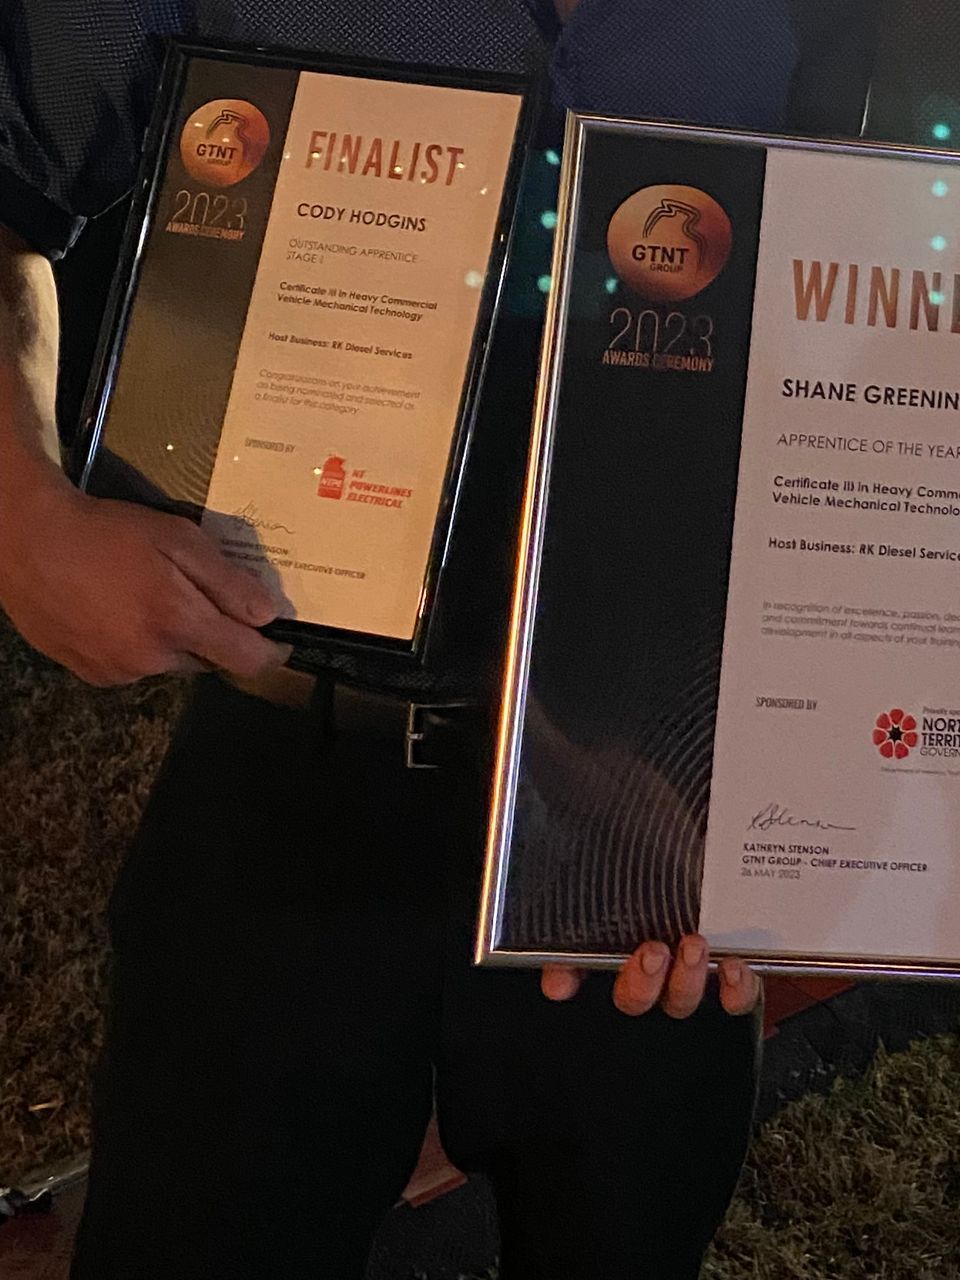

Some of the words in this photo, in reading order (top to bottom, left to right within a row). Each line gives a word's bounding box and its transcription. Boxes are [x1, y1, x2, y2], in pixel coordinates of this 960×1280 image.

[196, 143, 237, 160] GTNT
[305, 130, 465, 186] FINALIST
[172, 190, 248, 229] 2023
[297, 202, 346, 221] CODY
[349, 209, 426, 232] HODGINS
[286, 250, 317, 263] STAGE
[289, 238, 357, 256] OUTSTANDING
[360, 247, 419, 263] APPRENTICE
[632, 244, 690, 265] GTNT
[650, 263, 684, 273] GROUP
[279, 281, 327, 296] Certificate
[350, 291, 379, 304] Heavy
[381, 295, 438, 310] Commercial
[277, 294, 312, 306] Vehicle
[313, 298, 368, 313] Mechanical
[370, 305, 423, 322] Technology
[609, 308, 713, 356] 2023
[268, 331, 288, 342] Host
[345, 342, 373, 354] Diesel
[374, 345, 413, 360] Services
[602, 350, 650, 368] AWARDS
[782, 378, 857, 402] SHANE
[777, 433, 868, 453] APPRENTICE
[872, 439, 894, 454] OF
[899, 441, 923, 457] THE
[349, 480, 413, 498] POWERLINES
[773, 475, 839, 491] Certificate
[843, 480, 855, 492] III
[857, 481, 869, 493] in
[872, 483, 913, 498] Heavy
[347, 492, 403, 508] ELECTRICAL
[772, 492, 820, 506] Vehicle
[824, 496, 901, 512] Mechanical
[768, 537, 797, 550] Host
[800, 539, 855, 554] Business:
[859, 543, 875, 556] RK
[878, 545, 916, 558] Diesel
[756, 697, 804, 710] SPONSORED
[806, 699, 818, 711] BY
[743, 843, 785, 853] KATHRYN
[788, 845, 829, 855] STENSON
[742, 855, 766, 866] GTNT
[768, 856, 801, 867] GROUP
[810, 858, 837, 869] CHIEF
[839, 860, 888, 871] EXECUTIVE
[890, 862, 927, 872] OFFICER
